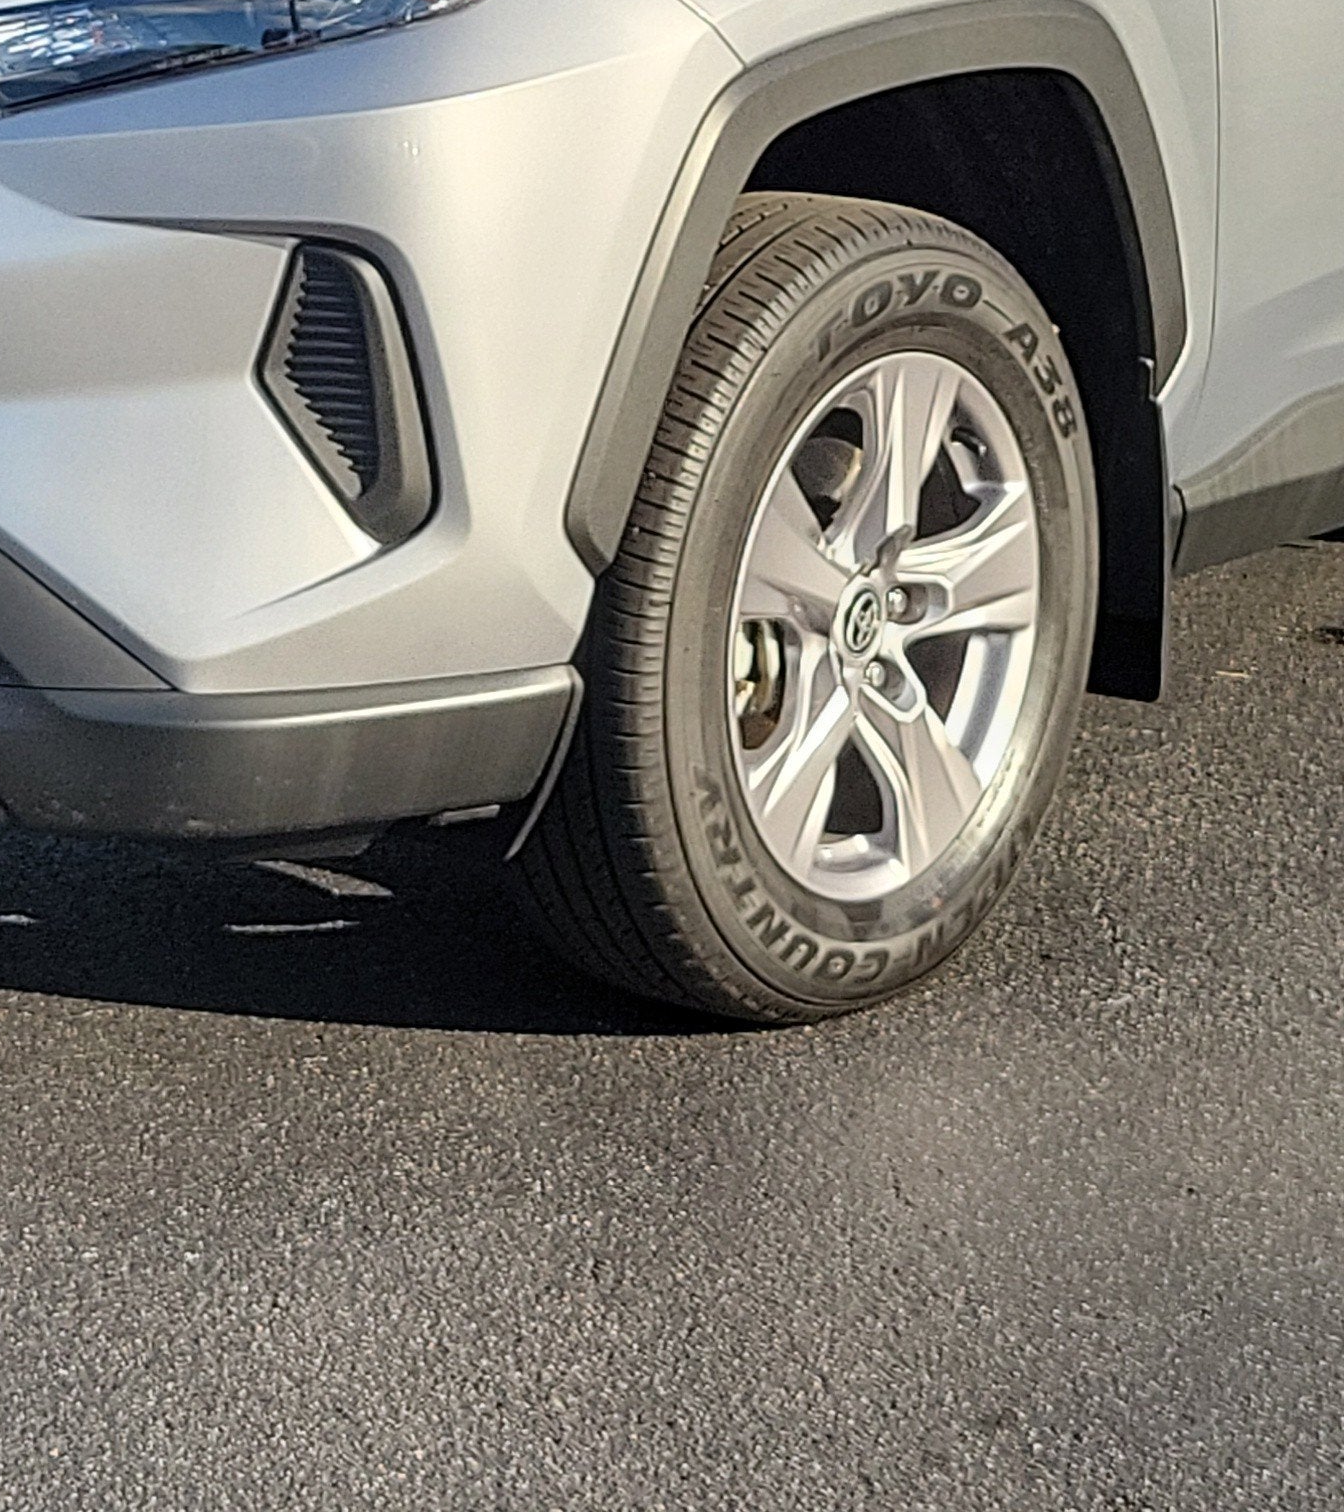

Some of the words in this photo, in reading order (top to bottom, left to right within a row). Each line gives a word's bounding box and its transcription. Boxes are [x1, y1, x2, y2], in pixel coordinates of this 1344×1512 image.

[816, 269, 983, 363] TOYO
[1002, 322, 1078, 439] A38
[692, 765, 892, 983] COUNTRY
